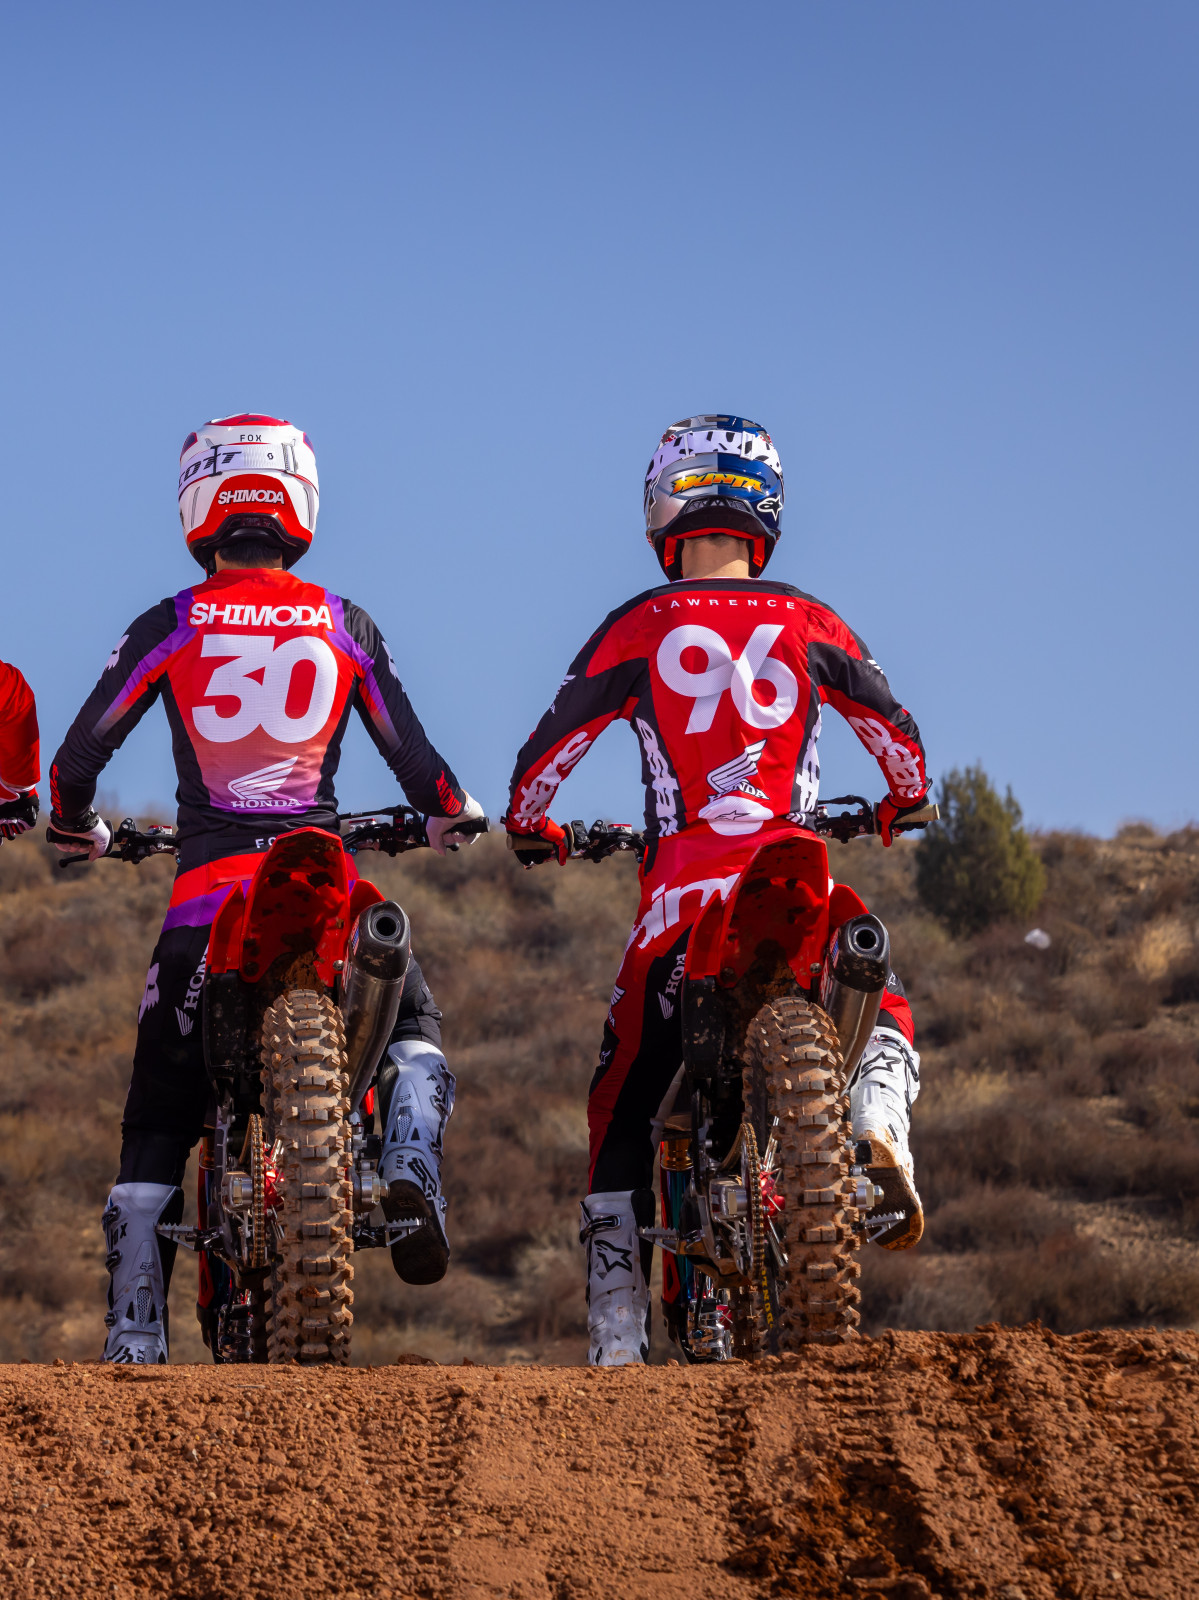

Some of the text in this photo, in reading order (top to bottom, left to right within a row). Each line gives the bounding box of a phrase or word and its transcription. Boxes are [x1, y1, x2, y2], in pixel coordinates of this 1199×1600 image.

[239, 434, 262, 443] FOX
[217, 489, 286, 506] SHIMODA
[653, 597, 796, 614] LAWRENCE
[188, 602, 335, 630] SHIMODA
[656, 623, 799, 735] 96
[191, 633, 339, 744] 30
[230, 798, 303, 810] HONDA
[396, 1154, 405, 1170] FOX
